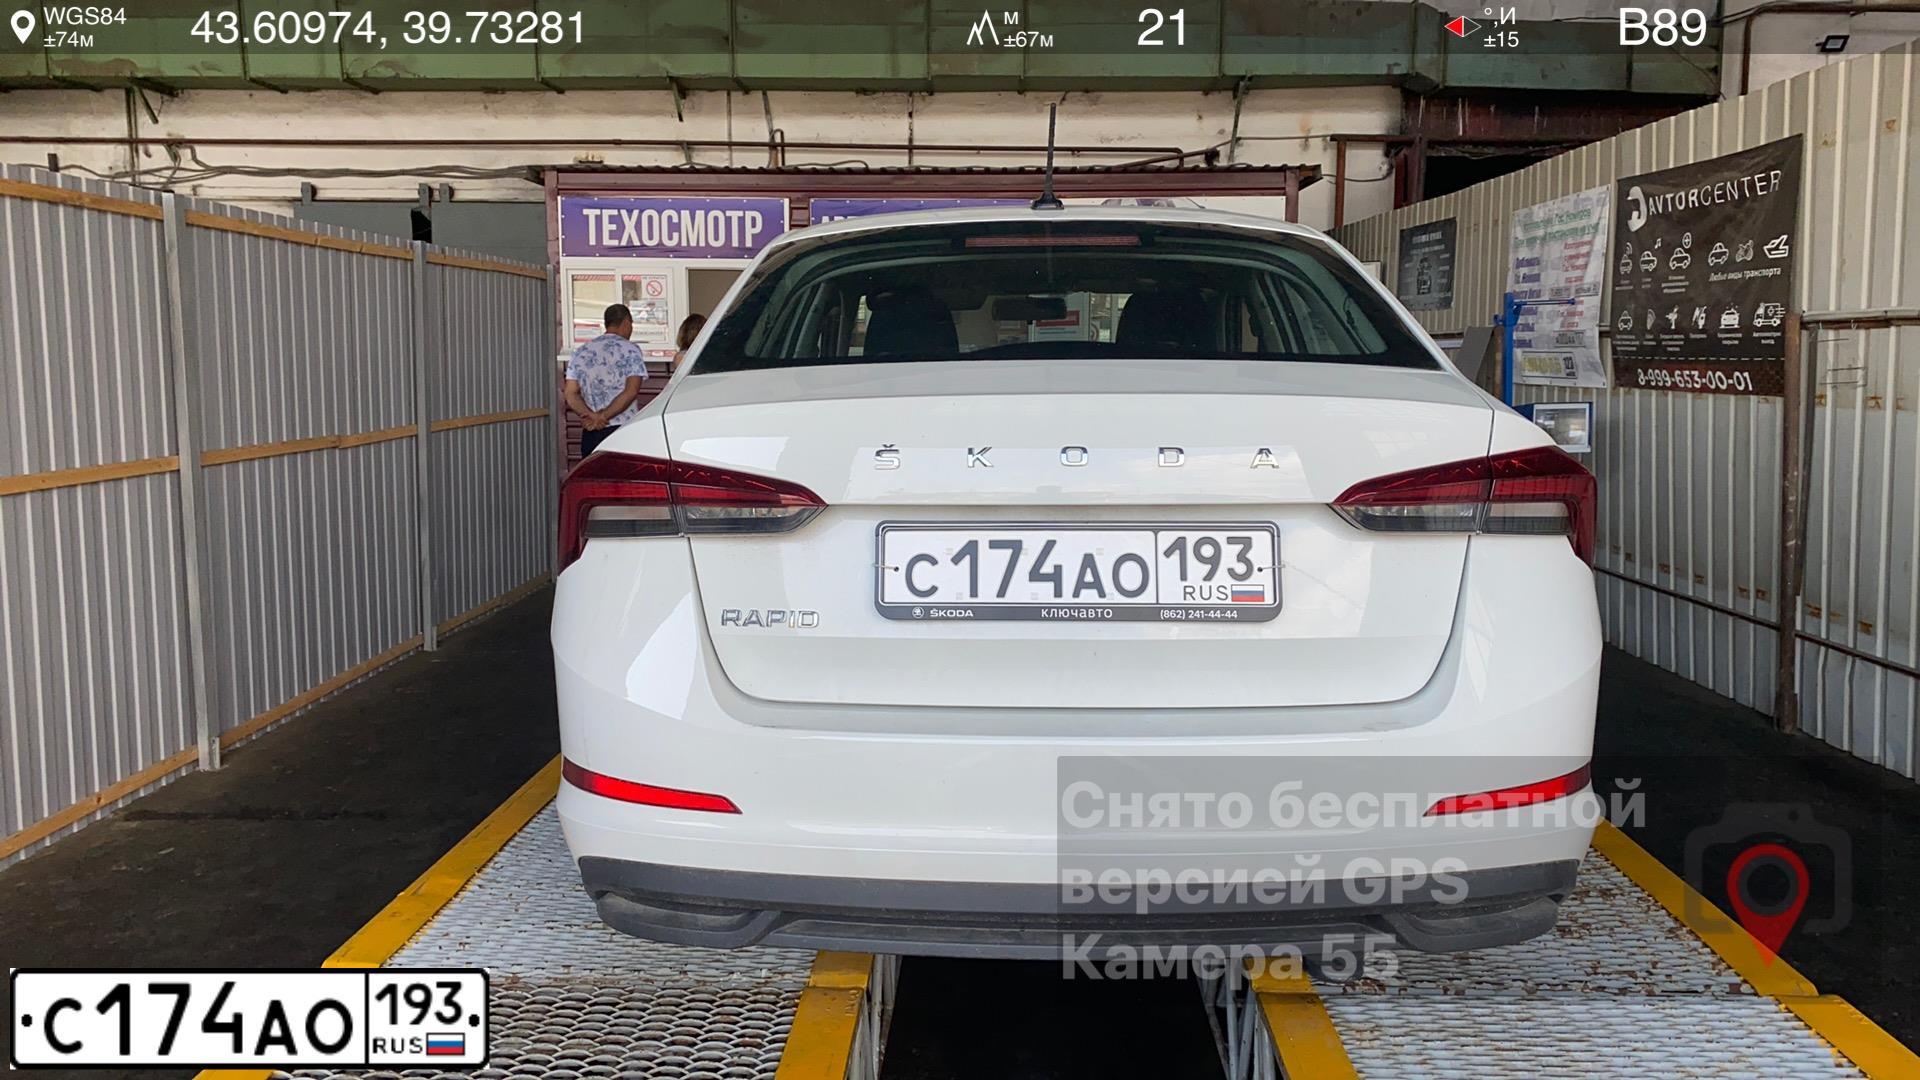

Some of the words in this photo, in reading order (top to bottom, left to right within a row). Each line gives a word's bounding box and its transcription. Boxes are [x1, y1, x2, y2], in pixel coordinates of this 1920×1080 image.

[1649, 170, 1782, 216] AVTORCENTER
[582, 208, 763, 248] ТЕХОСМОТР
[1743, 267, 1782, 280] транспорта
[1637, 368, 1753, 391] 8-999-653-00-01
[1163, 536, 1254, 582] 193
[1183, 585, 1229, 601] RUS
[721, 608, 820, 628] RAPID
[929, 608, 974, 618] ŠKODA
[1160, 609, 1186, 620] (862)
[1188, 609, 1238, 619] 241-44-44
